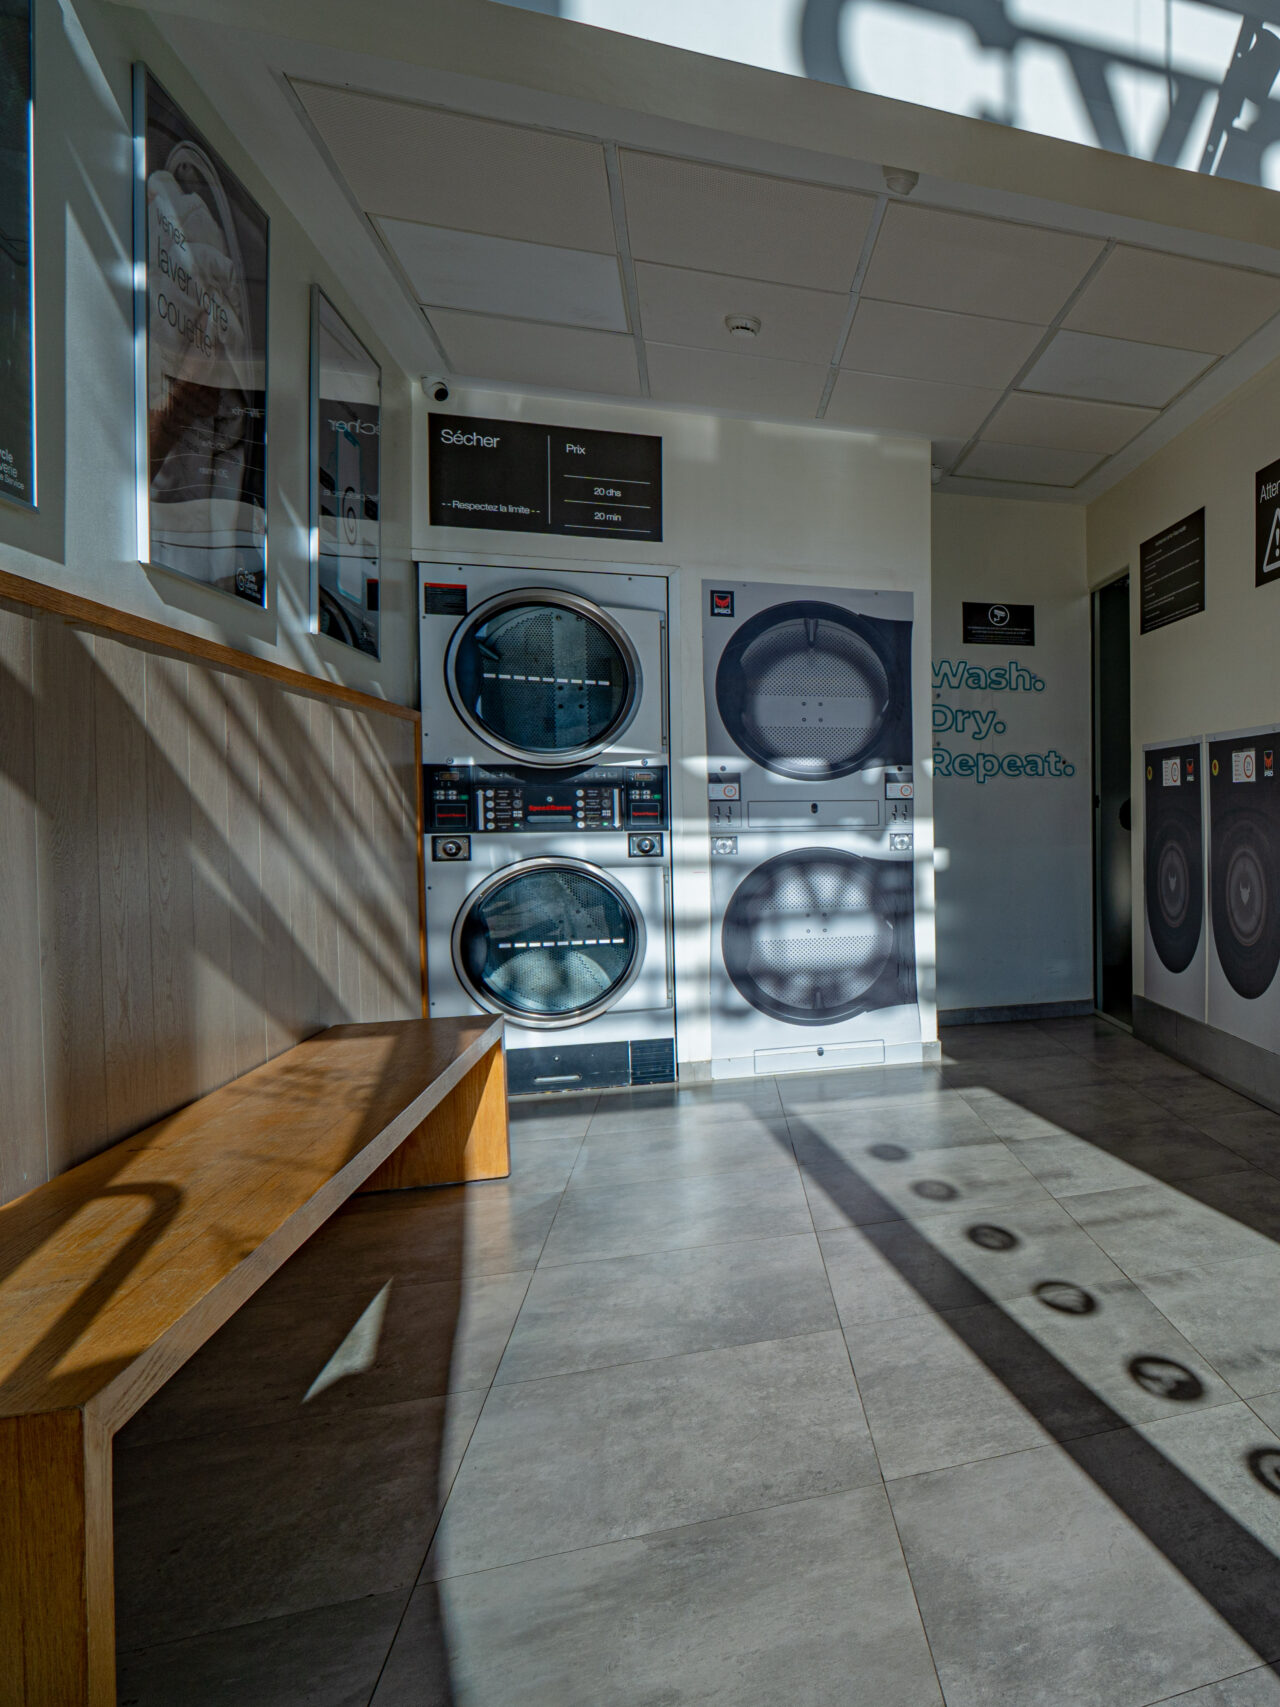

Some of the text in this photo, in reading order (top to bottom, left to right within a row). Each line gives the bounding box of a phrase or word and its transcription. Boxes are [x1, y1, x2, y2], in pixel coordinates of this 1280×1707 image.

[157, 208, 186, 251] venez
[158, 236, 228, 332] laver votre
[158, 293, 212, 357] couette
[440, 429, 501, 449] Sécher
[566, 444, 586, 456] Prix
[452, 501, 530, 515] Respectez la limite
[593, 487, 622, 498] 20 dhs
[594, 512, 622, 522] 20 min
[932, 660, 1045, 692] Wash.
[932, 703, 1006, 740] Dry.
[932, 747, 1075, 784] Repeat.
